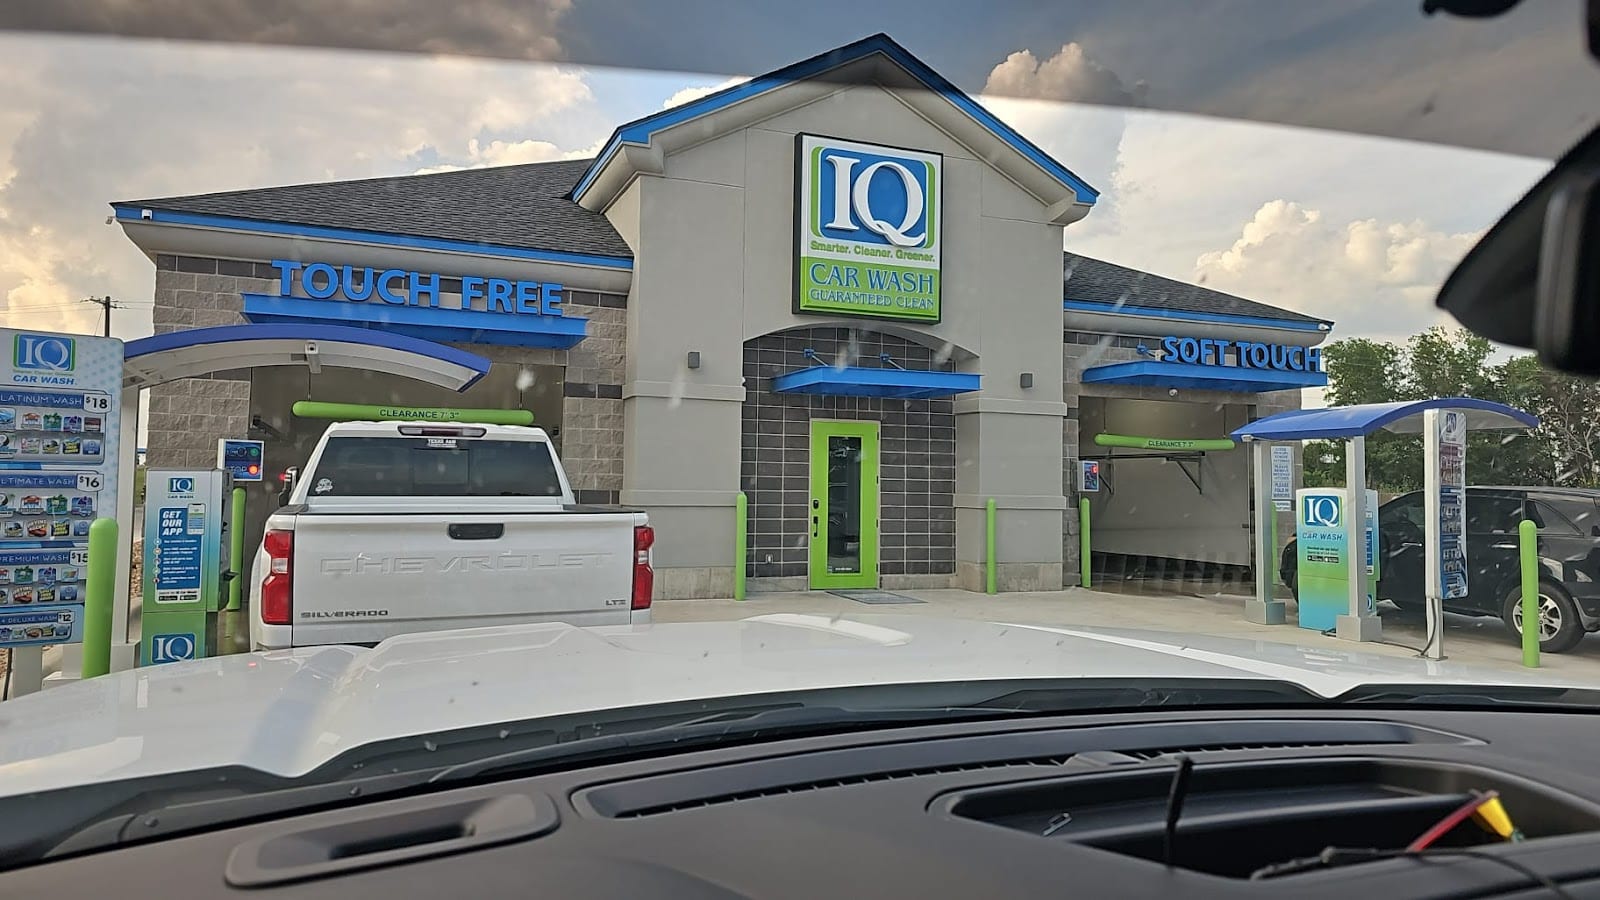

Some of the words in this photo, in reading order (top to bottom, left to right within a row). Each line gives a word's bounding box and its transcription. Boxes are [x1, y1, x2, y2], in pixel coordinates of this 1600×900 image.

[824, 155, 926, 246] IQ
[810, 240, 851, 254] Smarter.
[854, 245, 893, 258] Cleaner.
[896, 250, 936, 262] Greener.
[810, 264, 860, 288] CAR
[868, 269, 934, 294] WASH
[271, 260, 440, 307] TOUCH
[461, 276, 563, 316] FREE
[810, 288, 892, 306] GUARANTEED
[896, 296, 934, 310] CLEAN
[24, 338, 69, 371] IQ
[1162, 336, 1230, 366] SOFT
[1236, 341, 1321, 372] TOUCH
[13, 374, 38, 384] CAR
[42, 376, 74, 385] WASH
[0, 394, 49, 404] LATINUM
[52, 396, 82, 405] WASH
[86, 396, 108, 409] $18
[380, 408, 438, 419] CLEARANCE
[0, 477, 45, 485] LTIMATE
[79, 476, 100, 488] $16
[172, 478, 192, 493] IQ
[162, 510, 182, 519] GET
[1306, 498, 1339, 527] IQ
[162, 519, 182, 528] OUR
[162, 528, 183, 536] APP
[72, 552, 88, 563] $15
[320, 552, 613, 576] CHEVROLET
[300, 609, 388, 618] SILVERADO
[155, 636, 194, 662] IQ
